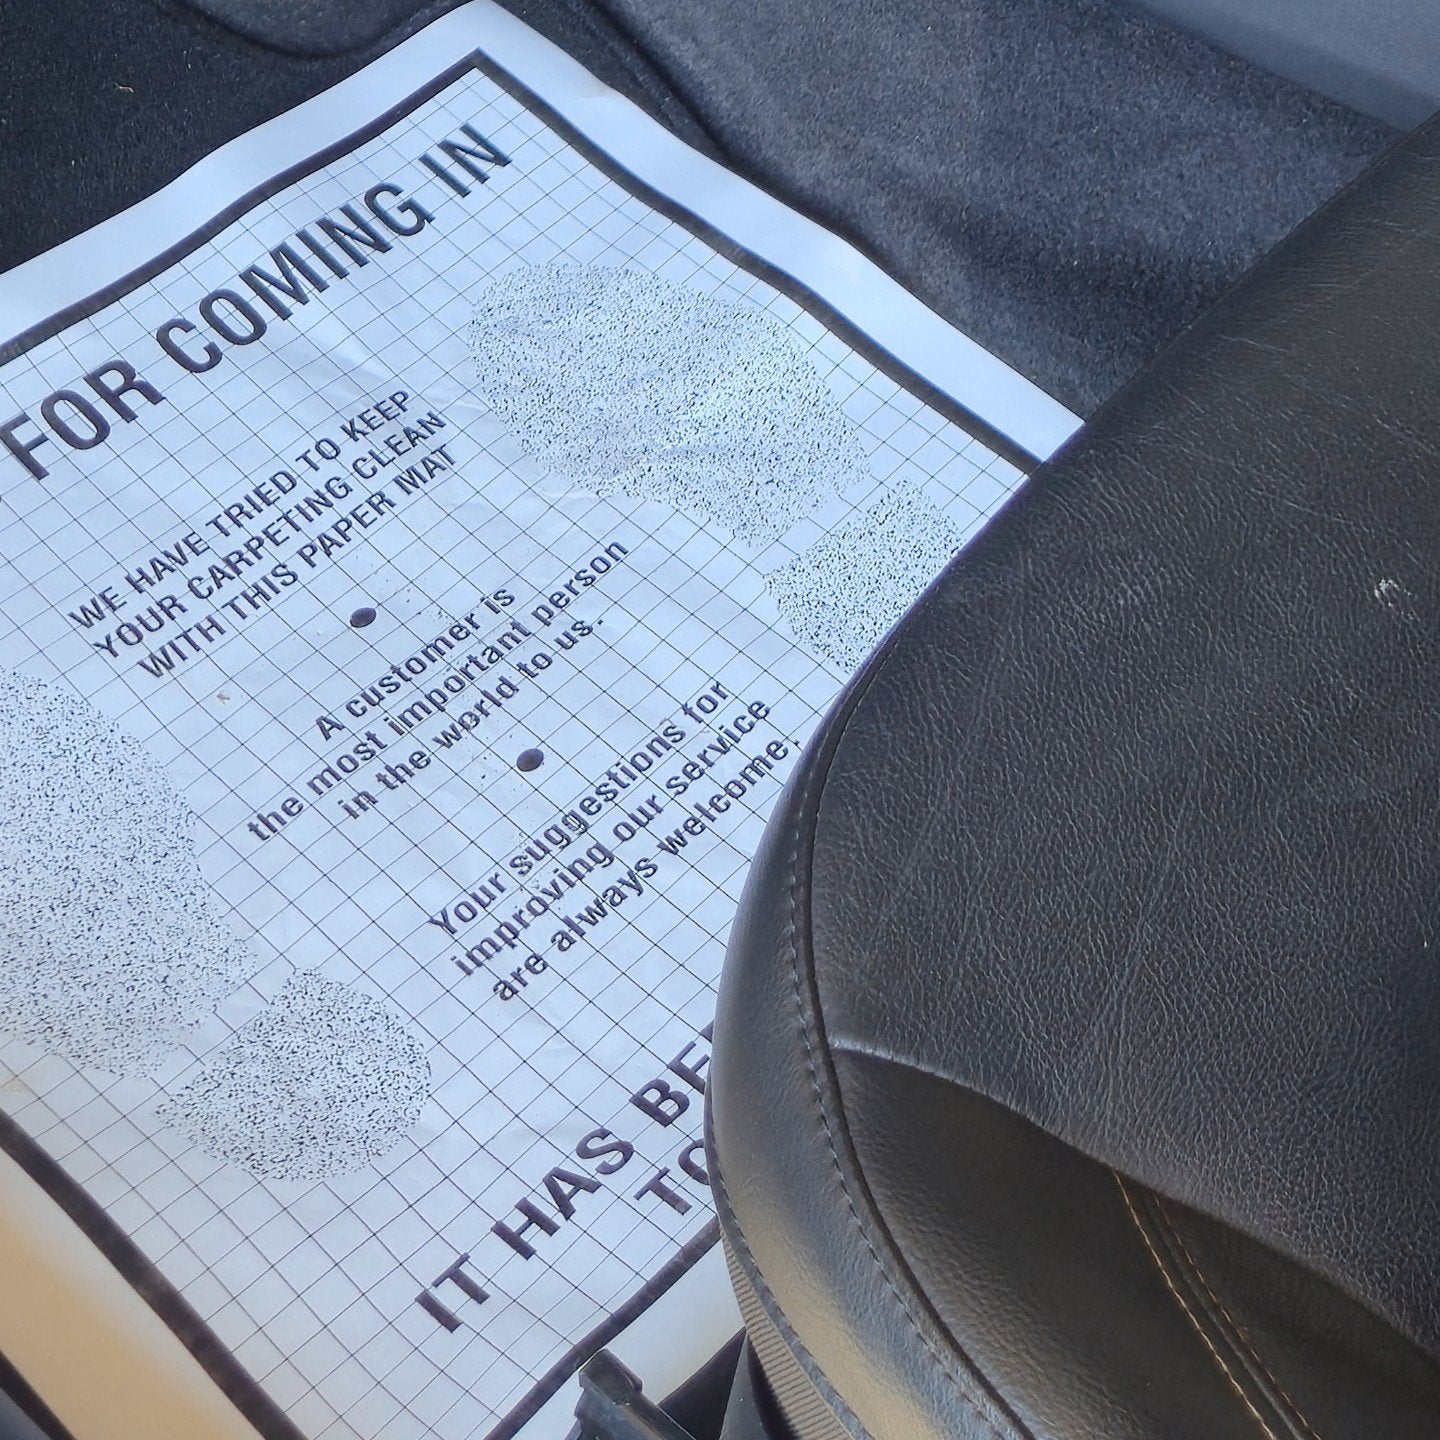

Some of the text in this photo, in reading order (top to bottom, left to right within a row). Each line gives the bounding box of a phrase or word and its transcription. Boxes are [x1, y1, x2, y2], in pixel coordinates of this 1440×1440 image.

[156, 181, 436, 374] COMING
[418, 122, 513, 199] IN
[67, 389, 411, 630] WE HAVE TRIED TO KEEP
[93, 410, 448, 659] YOUR CARPETING CLEAN
[136, 444, 459, 679] WITH THIS PAPER MAT
[247, 539, 630, 843] the most important person
[314, 586, 516, 741] A customer is
[337, 618, 605, 821] in the world to us.
[429, 680, 731, 938] Your suggestions for
[450, 699, 771, 977] improving our service
[492, 951, 550, 1003] are
[550, 855, 660, 952] always
[415, 1021, 714, 1334] IT HAS BE
